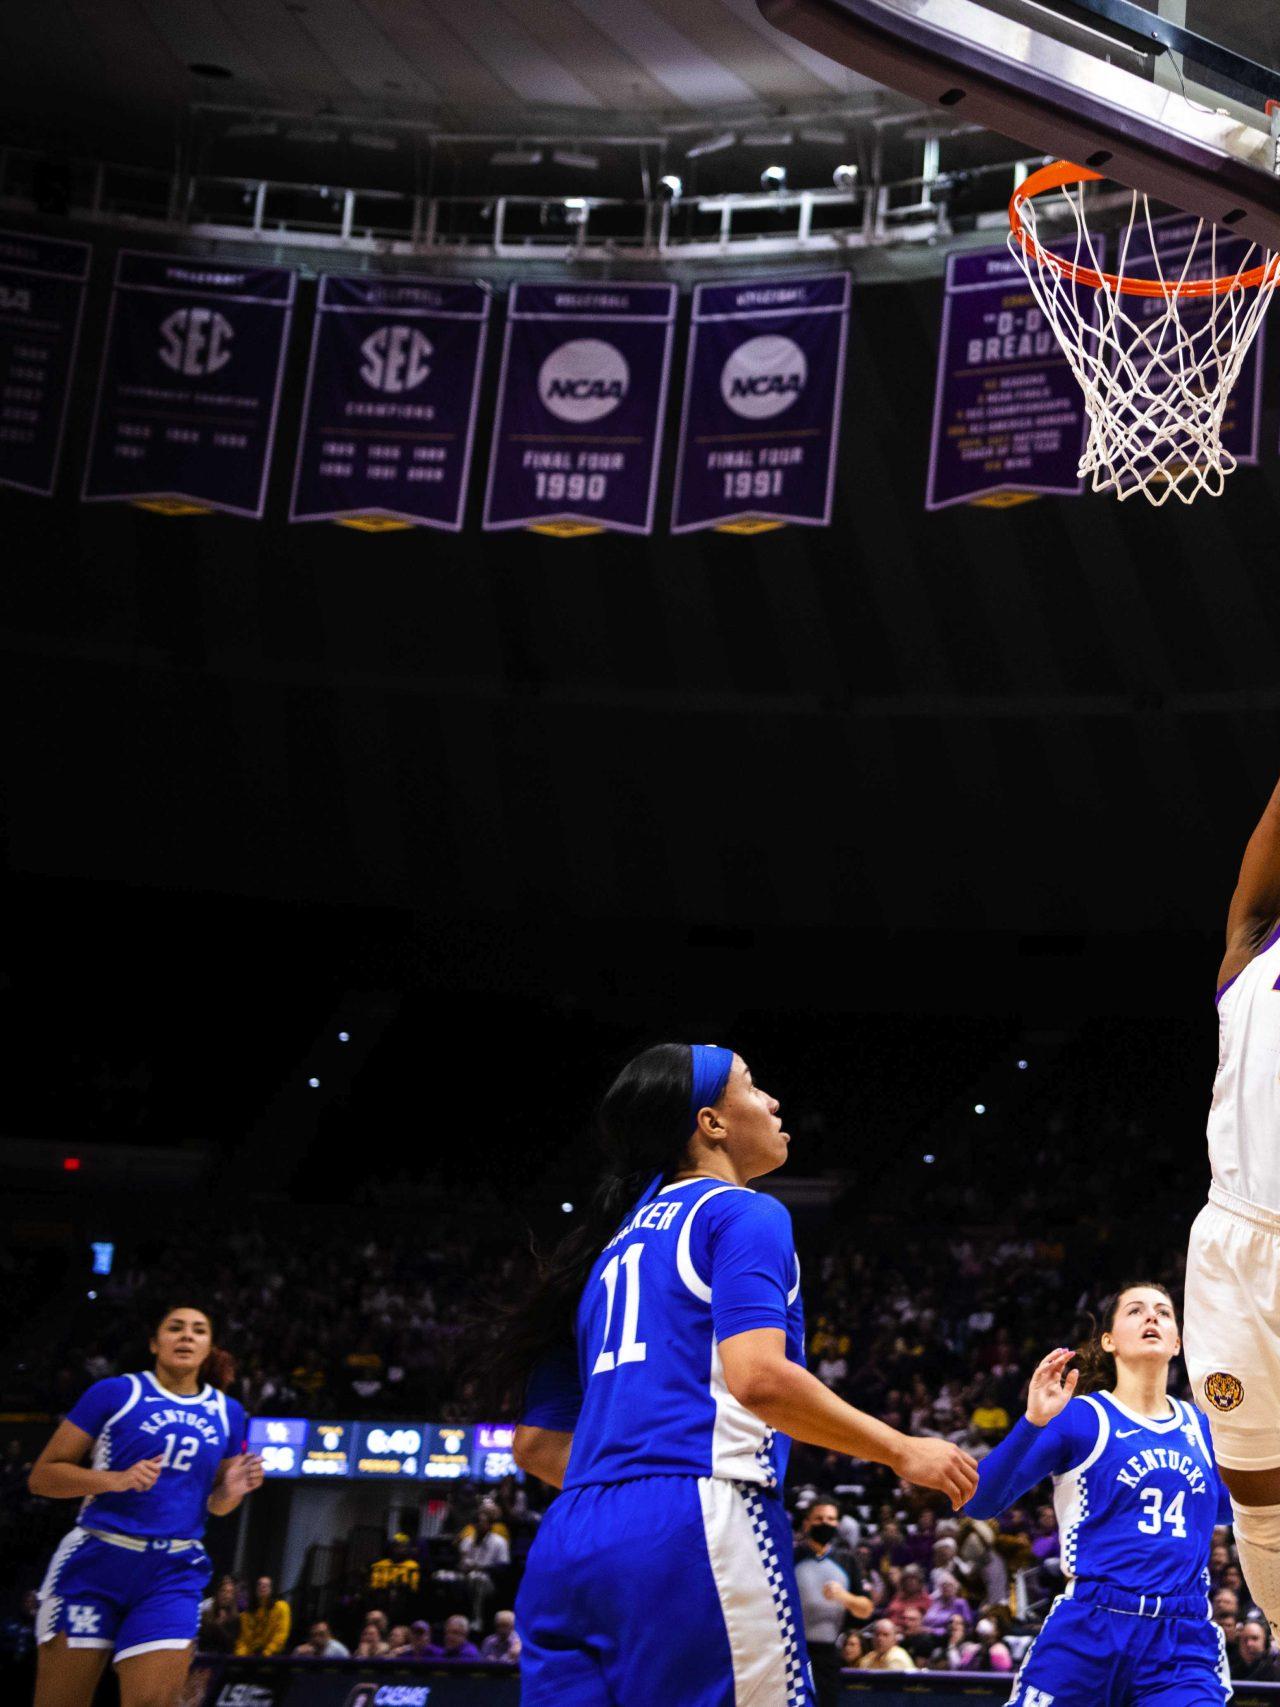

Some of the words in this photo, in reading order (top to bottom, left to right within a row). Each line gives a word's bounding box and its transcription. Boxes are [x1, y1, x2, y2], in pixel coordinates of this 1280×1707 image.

[157, 306, 236, 377] SEC
[358, 324, 435, 394] SEC
[548, 379, 624, 399] NCAA
[730, 374, 802, 398] NCAA
[522, 449, 571, 471] FINAL
[576, 451, 625, 472] FOUR
[706, 450, 754, 471] FINAL
[758, 445, 804, 466] FOUR
[535, 472, 608, 502] 1990
[723, 468, 784, 500] 1991
[591, 1242, 647, 1375] 11
[138, 1409, 219, 1446] KENTUCKY
[161, 1433, 199, 1472] 12
[1116, 1448, 1206, 1494] KENTUCKY
[1137, 1487, 1187, 1539] 34
[67, 1604, 102, 1634] UK
